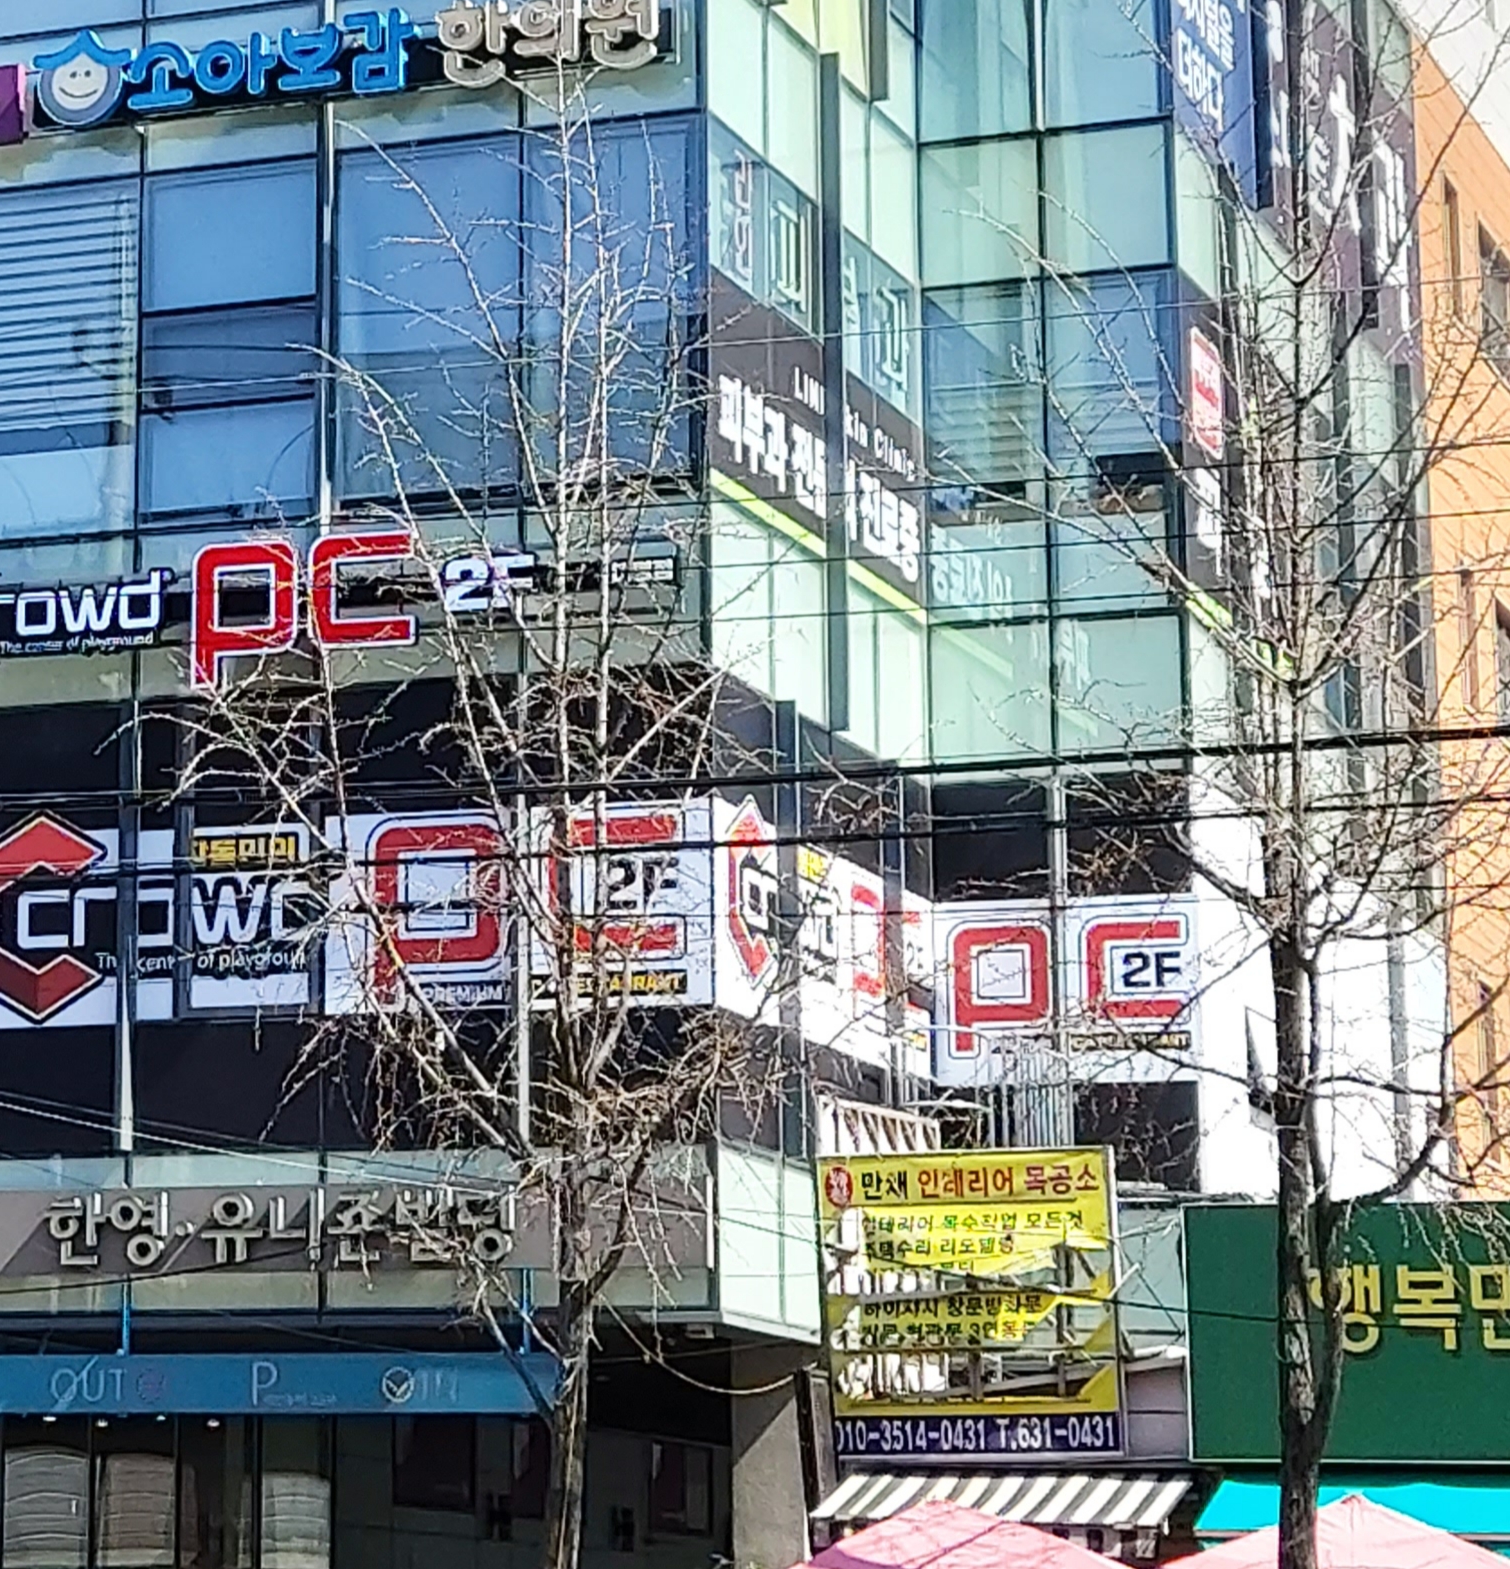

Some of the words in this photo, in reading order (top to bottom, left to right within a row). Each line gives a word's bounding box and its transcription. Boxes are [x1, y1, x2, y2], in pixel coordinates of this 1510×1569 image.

[126, 5, 422, 110] 소아보감
[719, 373, 788, 494] 피부과
[191, 528, 418, 690] PC
[952, 919, 1186, 1054] PC
[1122, 949, 1184, 989] 2F
[917, 1166, 1014, 1199] 인테리어
[1023, 1161, 1100, 1195] 목공소
